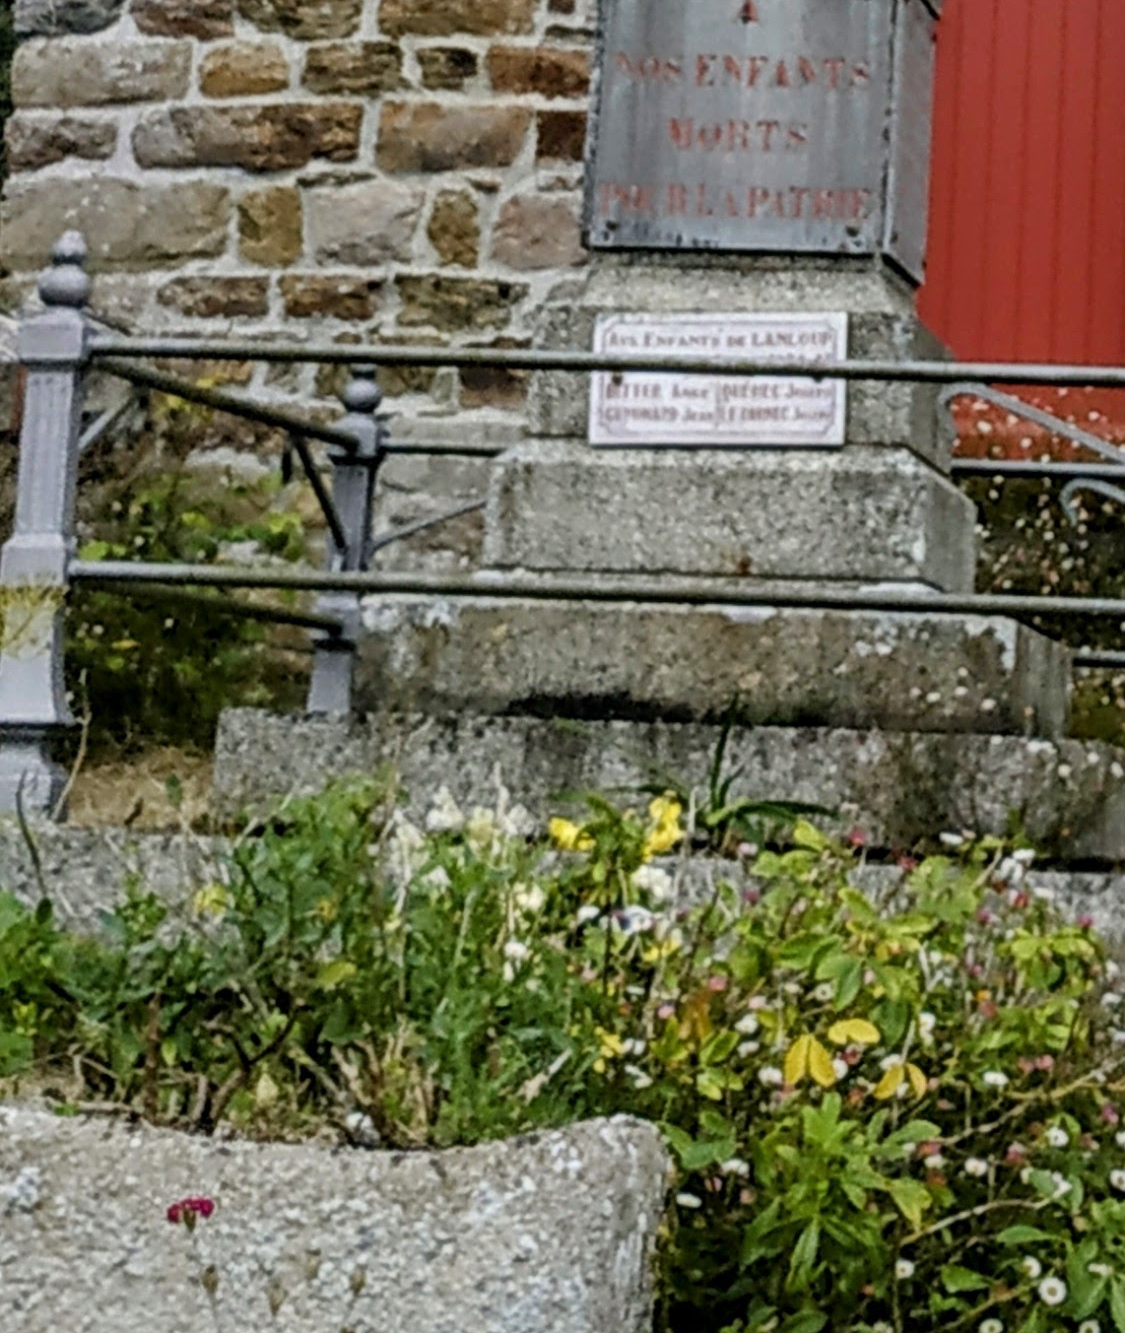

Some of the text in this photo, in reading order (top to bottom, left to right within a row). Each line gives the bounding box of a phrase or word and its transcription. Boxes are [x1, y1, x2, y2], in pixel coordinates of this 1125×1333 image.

[615, 51, 871, 88] NOS ENFANTS
[668, 118, 808, 153] MORTS
[696, 183, 739, 218] LA
[747, 186, 872, 220] PATRIE
